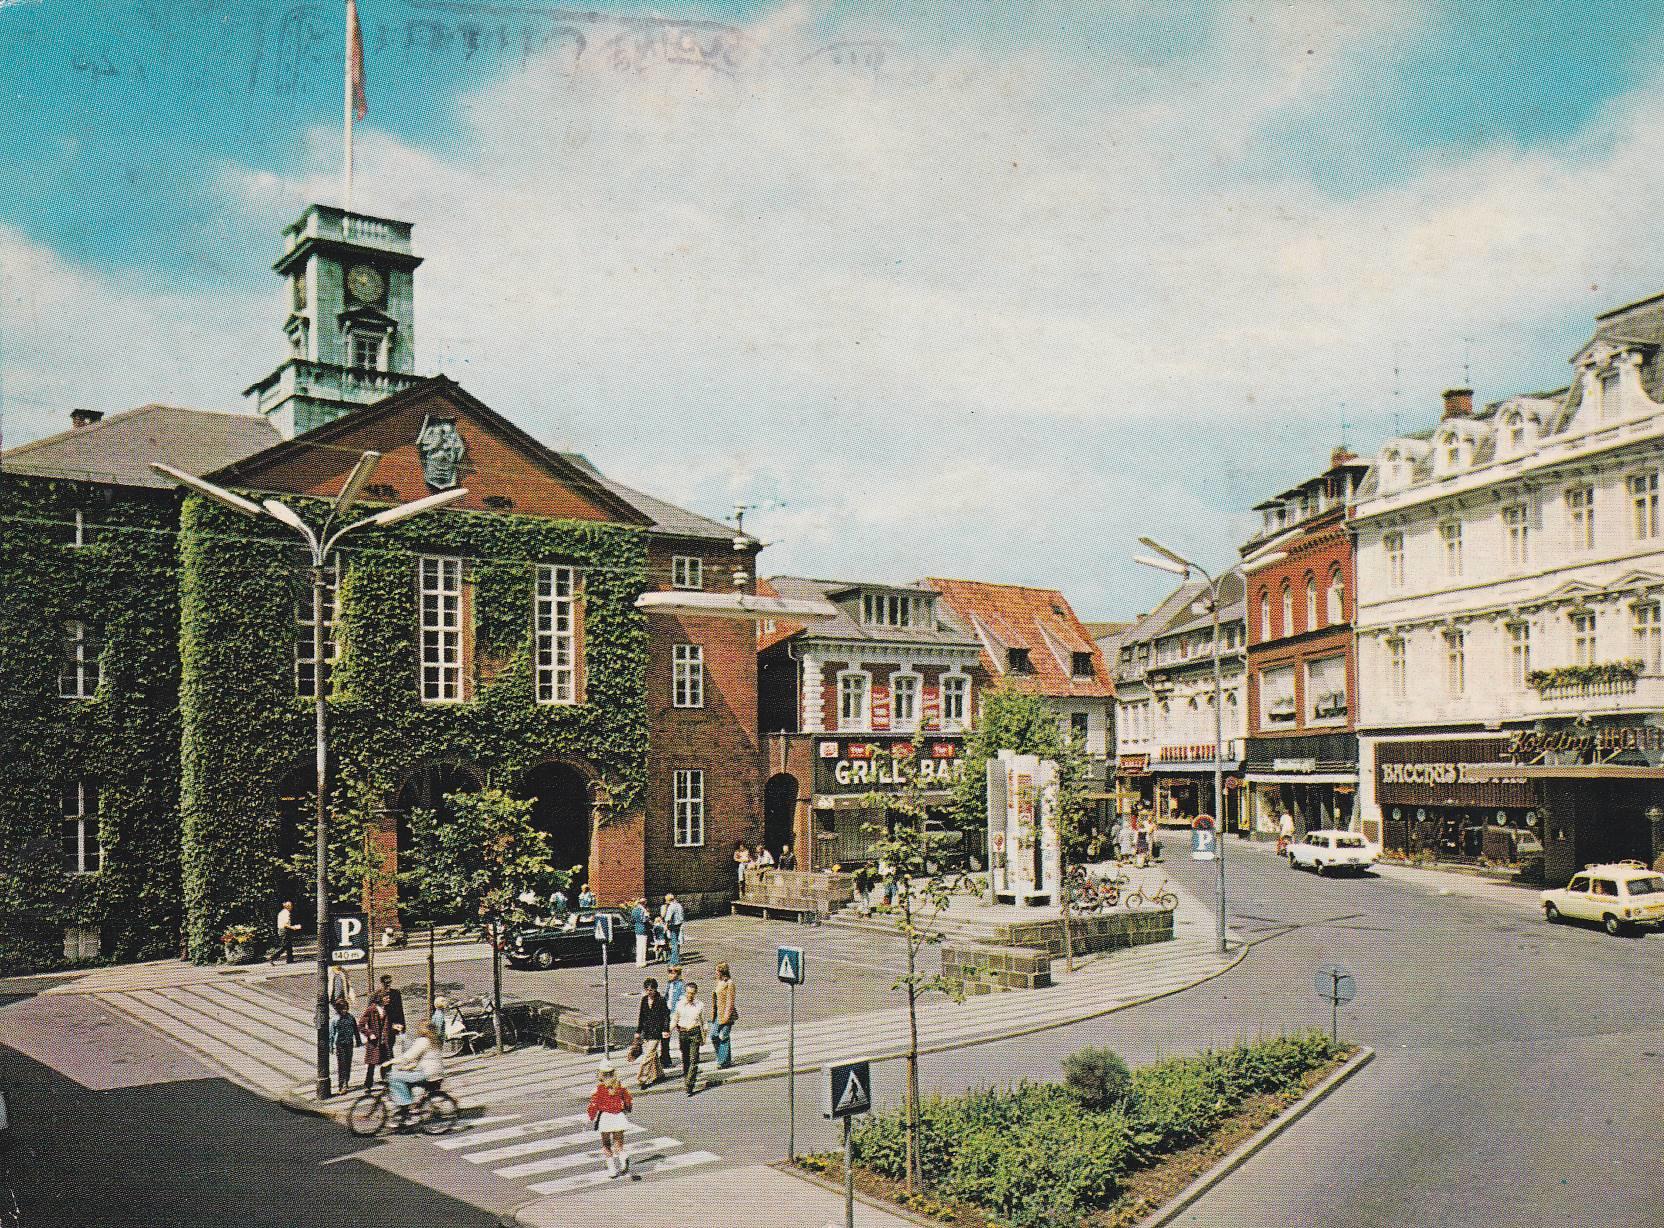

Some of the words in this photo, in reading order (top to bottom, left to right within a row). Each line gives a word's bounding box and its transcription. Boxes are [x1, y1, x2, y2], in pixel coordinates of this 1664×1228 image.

[835, 759, 906, 785] GRILL
[1196, 830, 1213, 850] P
[337, 917, 362, 947] P
